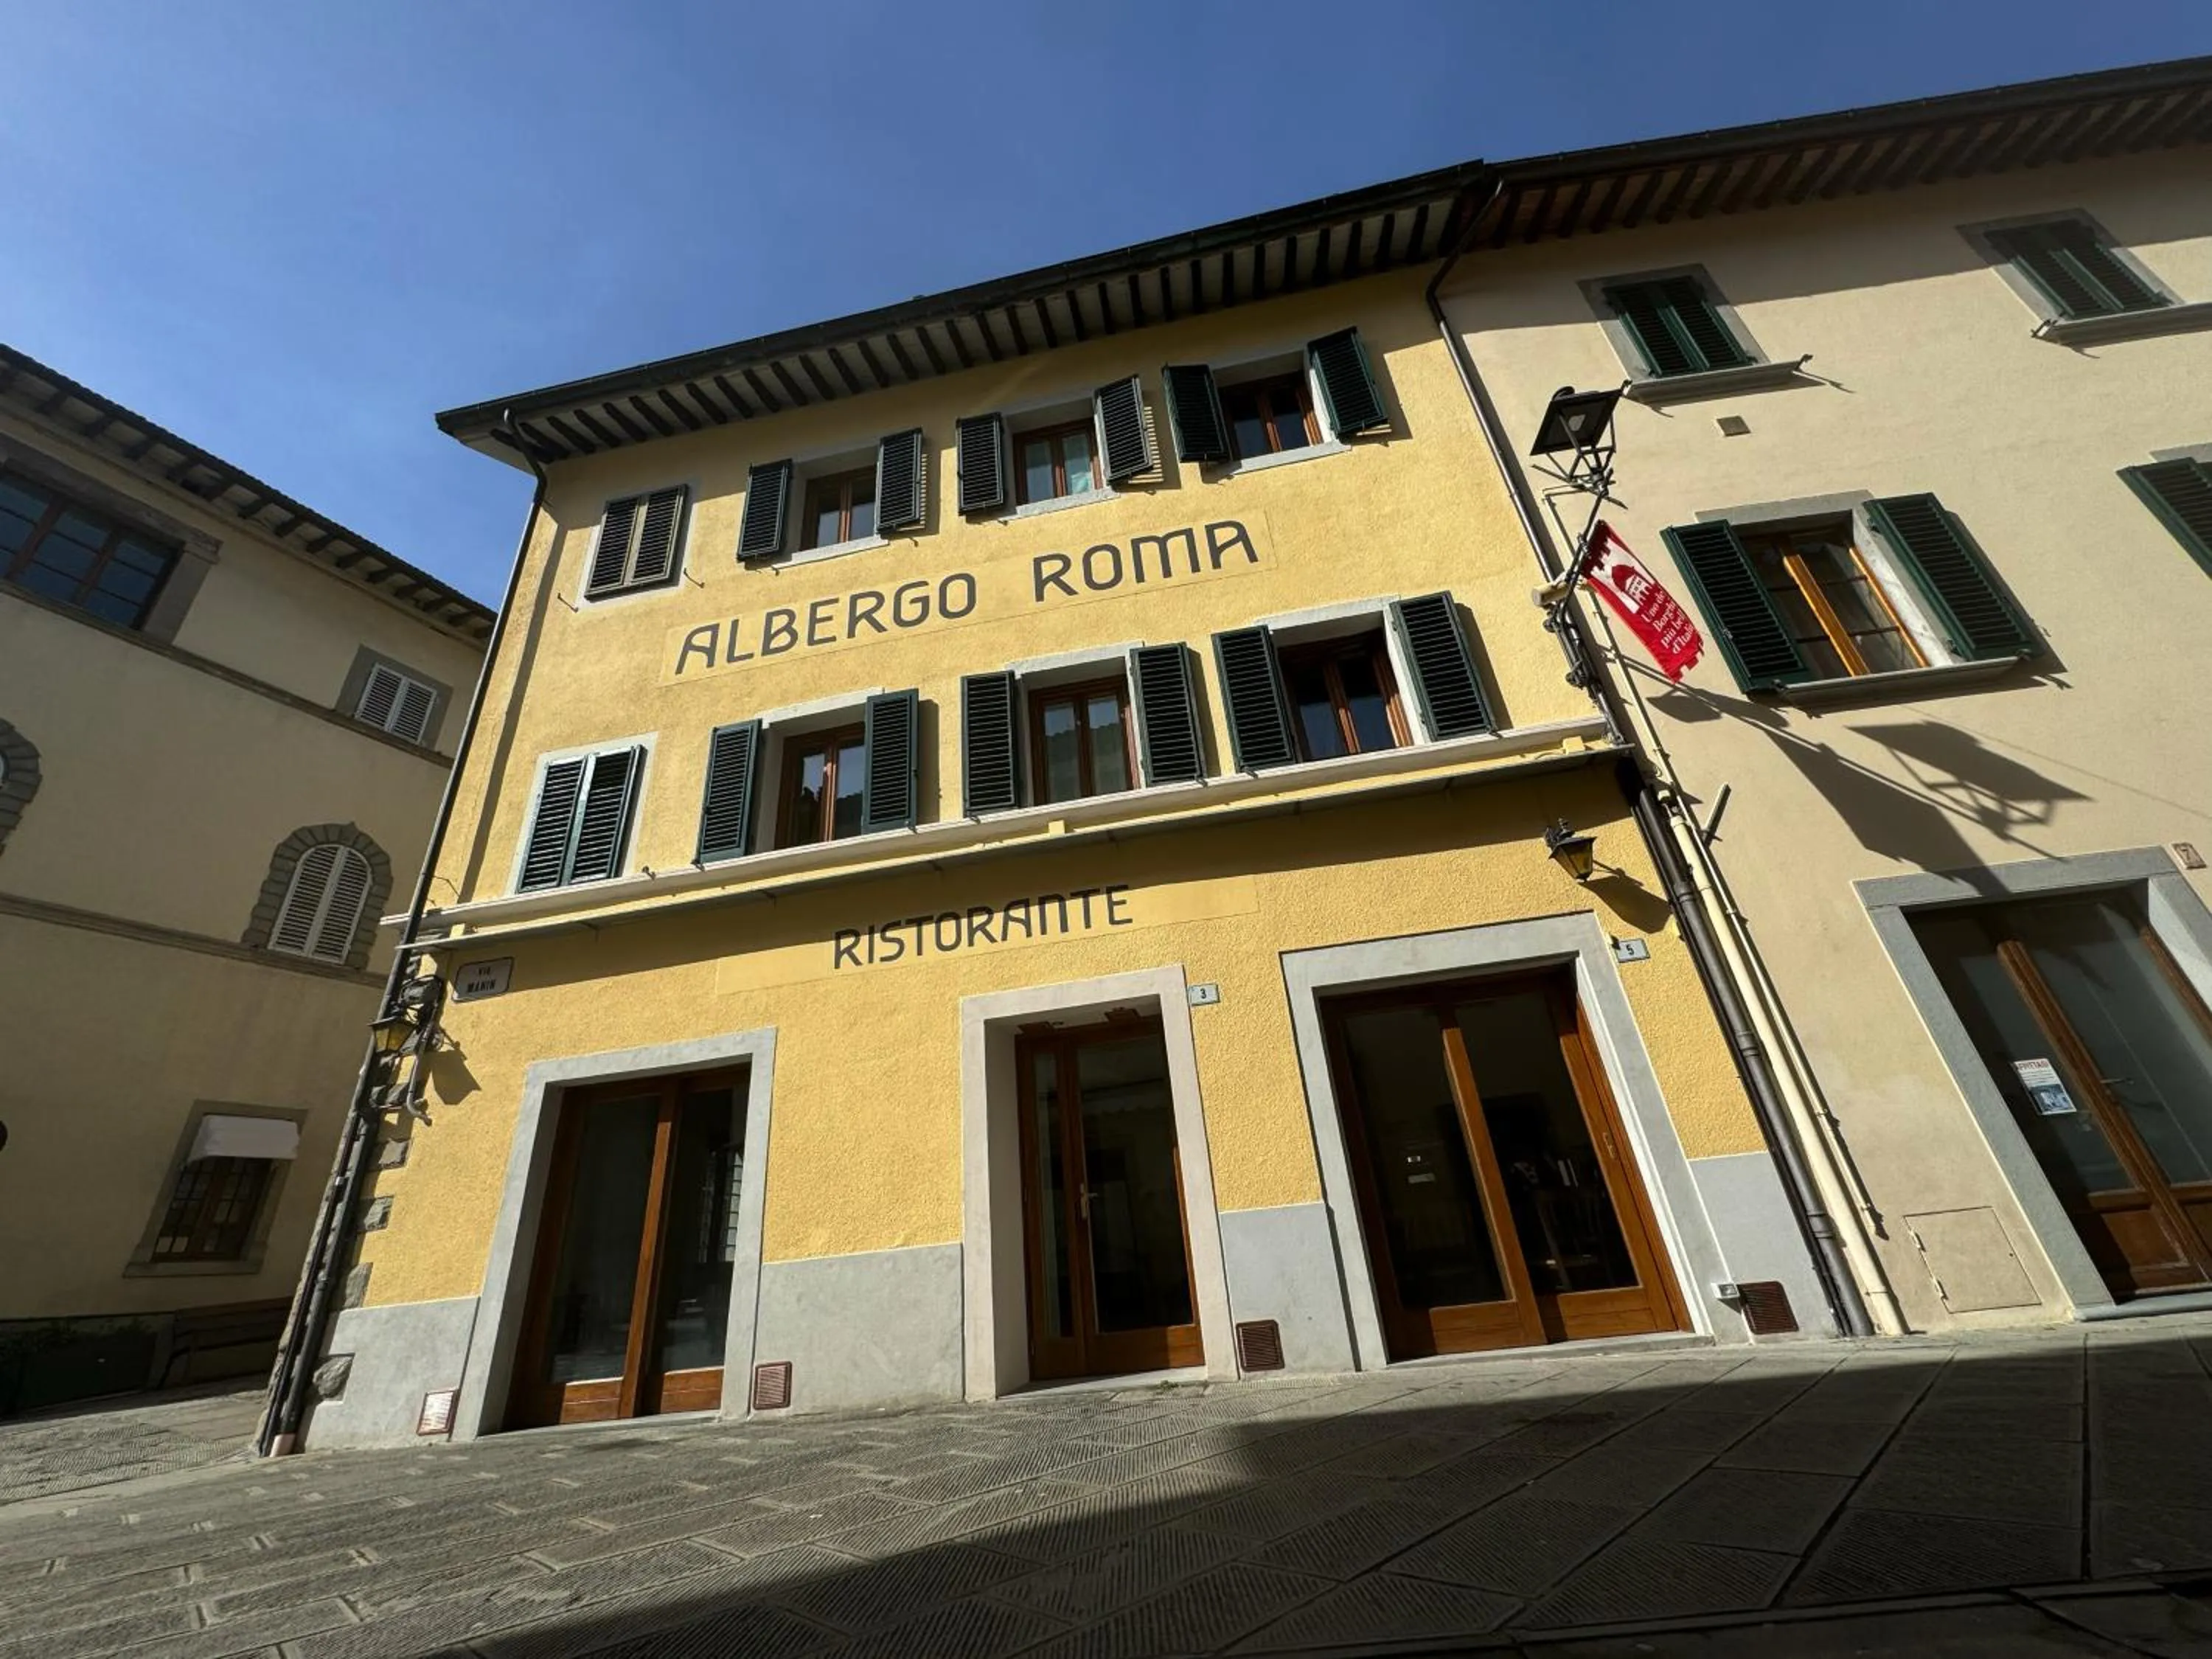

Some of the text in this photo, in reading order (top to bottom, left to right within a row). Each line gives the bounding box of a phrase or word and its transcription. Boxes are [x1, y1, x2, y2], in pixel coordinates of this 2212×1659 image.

[675, 520, 1259, 675] ALBERGO ROMA
[834, 884, 1133, 970] RISTORANTE
[1626, 943, 1635, 956] 5
[1200, 988, 1207, 999] 3
